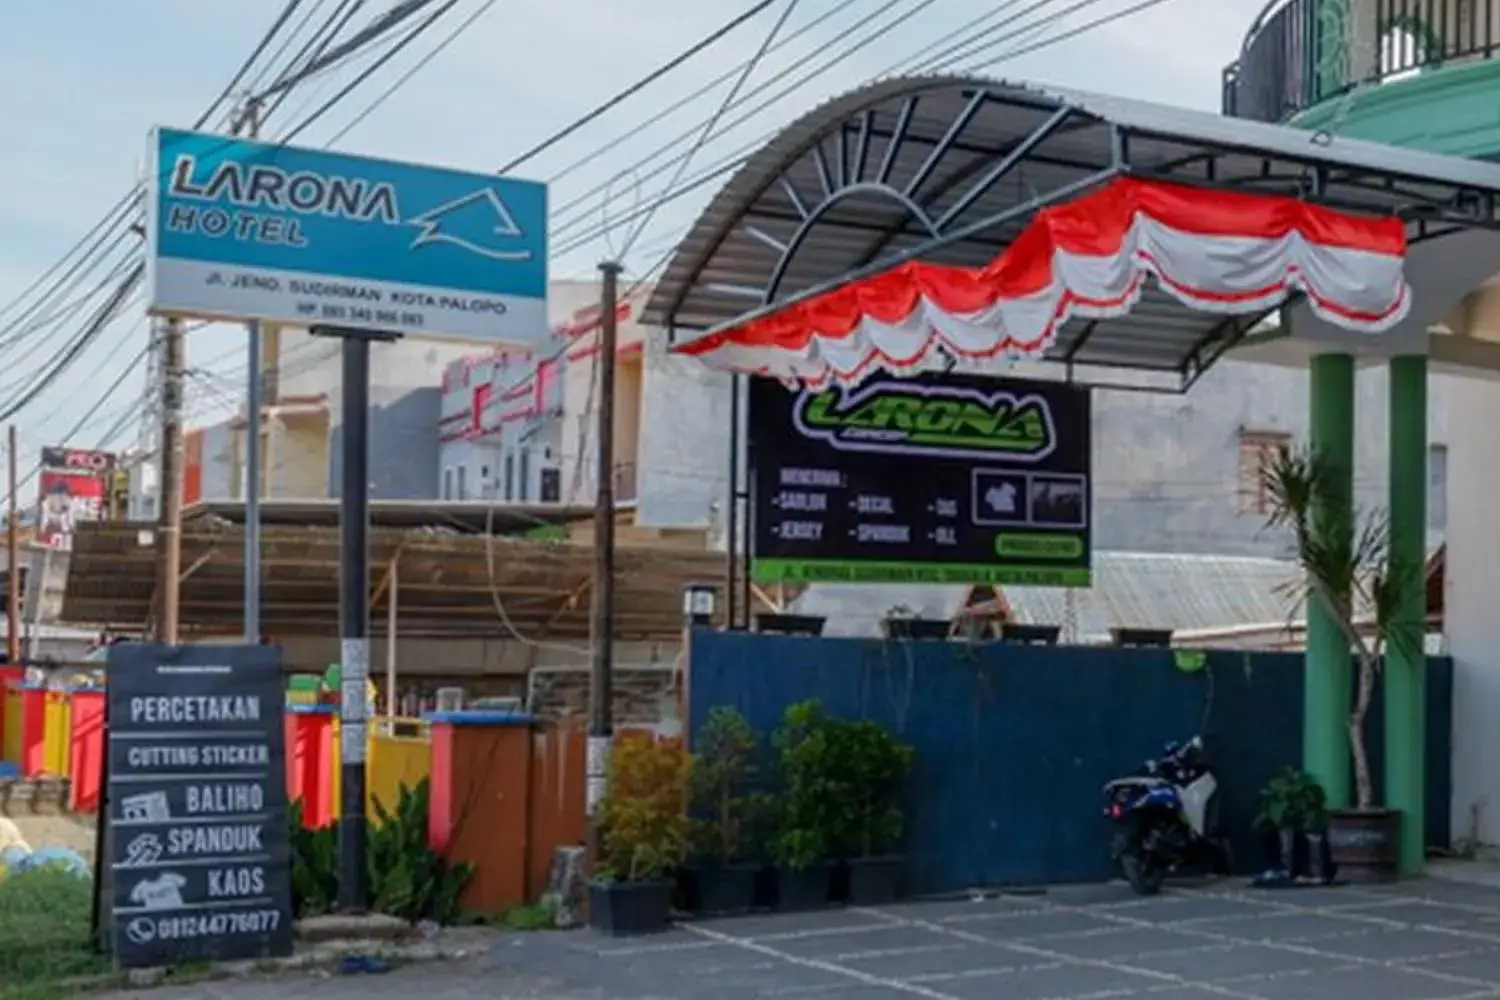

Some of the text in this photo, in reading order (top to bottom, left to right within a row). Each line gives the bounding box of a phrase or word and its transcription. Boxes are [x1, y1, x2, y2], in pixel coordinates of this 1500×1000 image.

[170, 155, 400, 224] LARONA
[168, 206, 310, 246] HOTEL
[390, 290, 436, 306] KOTA
[439, 295, 508, 315] PALOPO
[807, 391, 1044, 438] LARONA
[130, 695, 260, 723] PERCETAKAN
[128, 745, 270, 768] CUTTING STICKER
[186, 785, 265, 813] BALIHO
[167, 825, 264, 854] SPANDUK
[207, 868, 265, 897] KAOS
